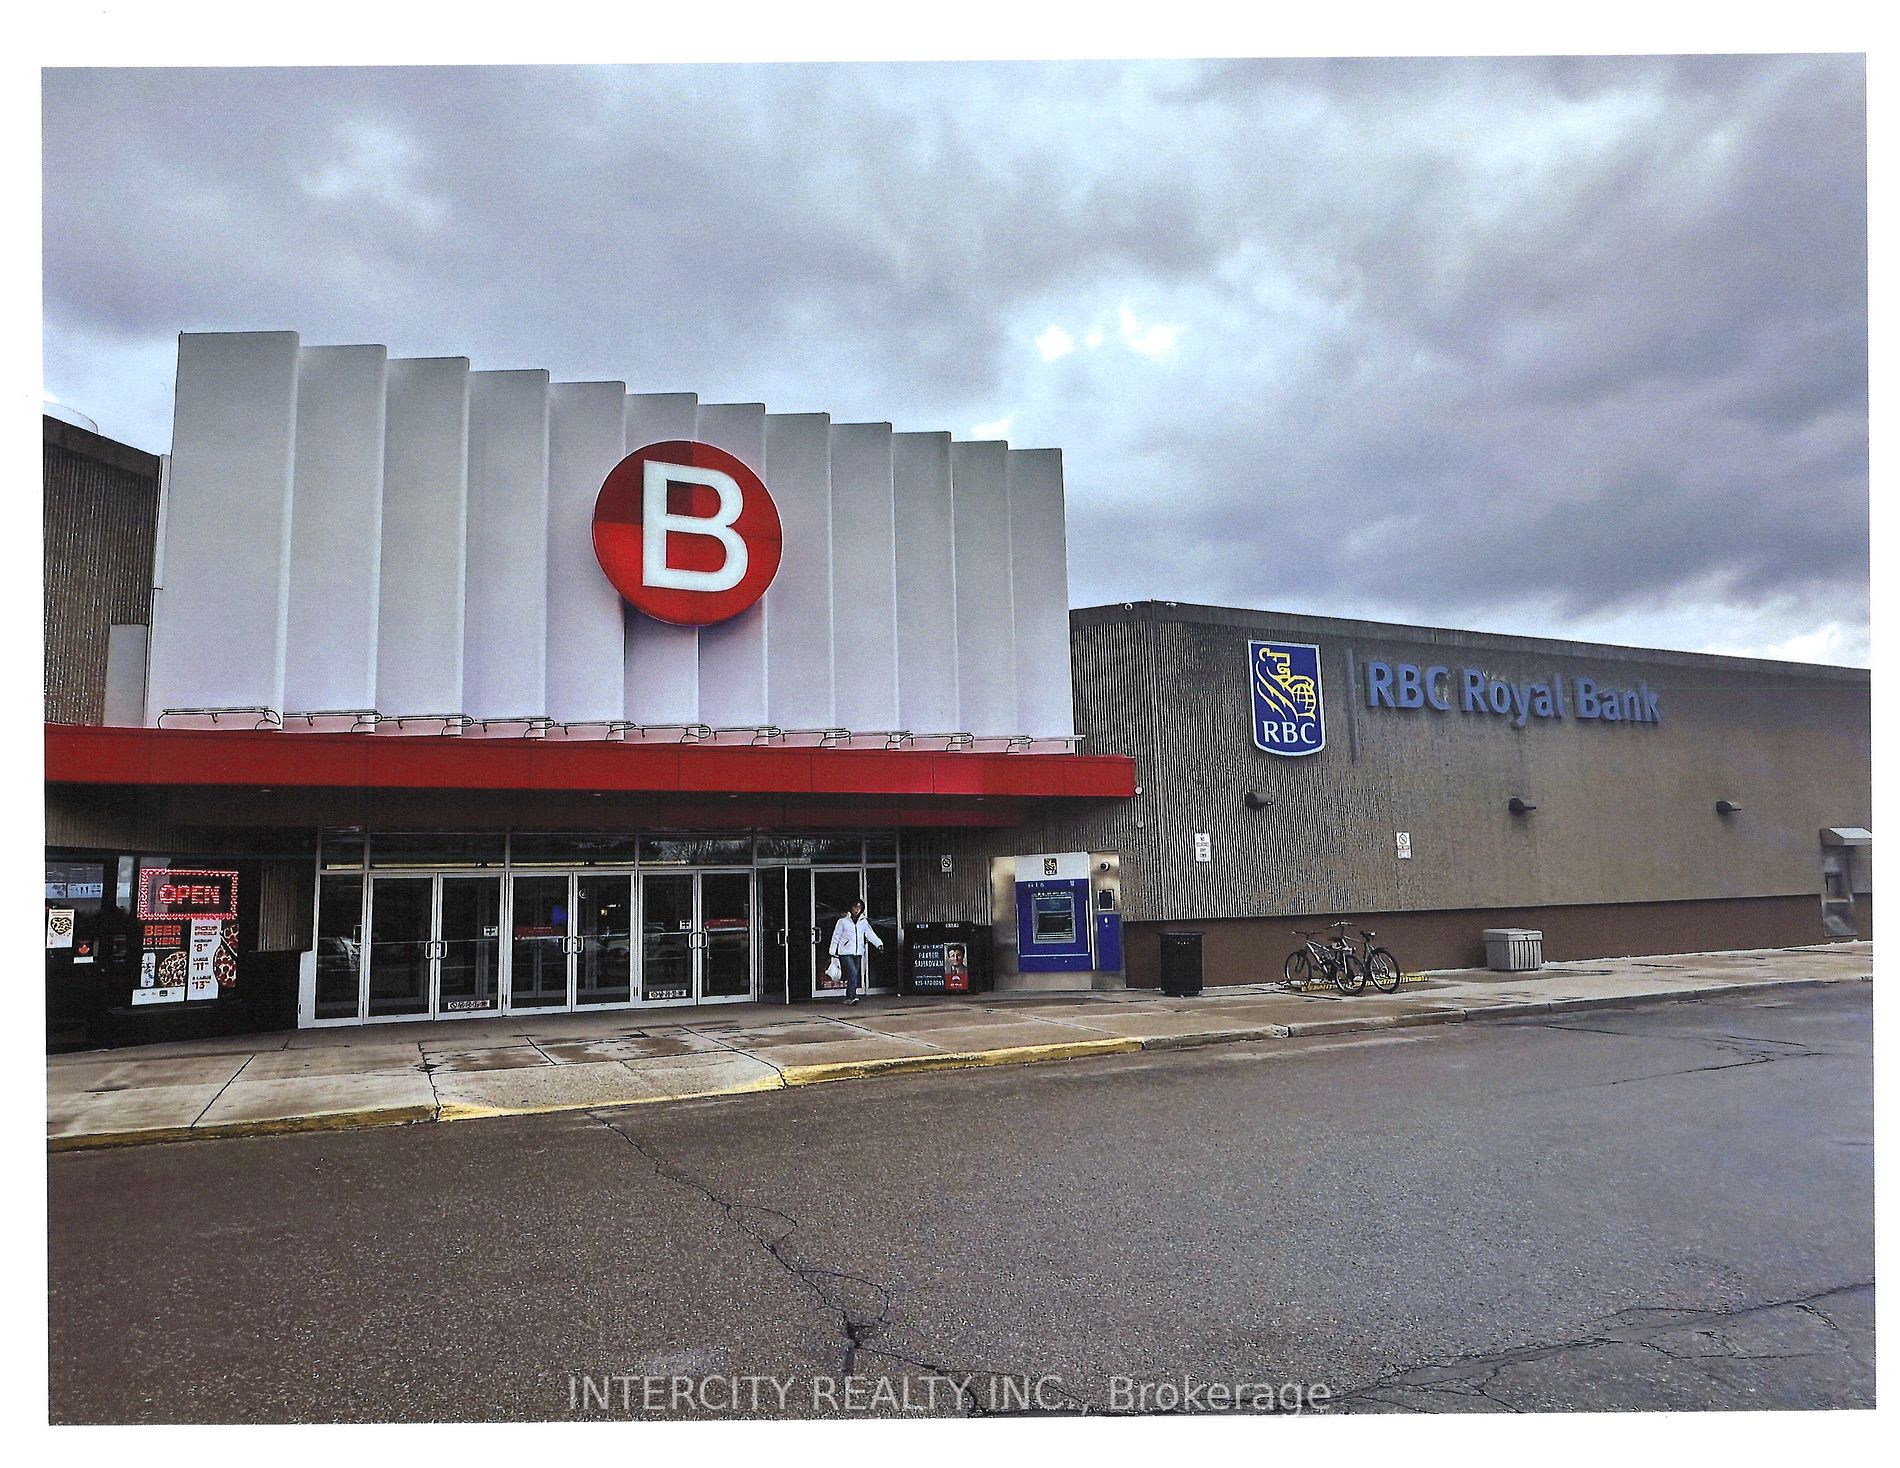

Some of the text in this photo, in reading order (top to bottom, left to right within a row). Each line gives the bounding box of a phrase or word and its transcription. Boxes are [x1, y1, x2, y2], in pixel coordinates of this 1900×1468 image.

[641, 459, 749, 593] B
[1366, 660, 1663, 728] RBC Royal Bank
[1262, 720, 1317, 744] RBC
[159, 884, 220, 904] OPEN
[142, 937, 181, 946] IS HERE
[144, 925, 182, 937] BEER
